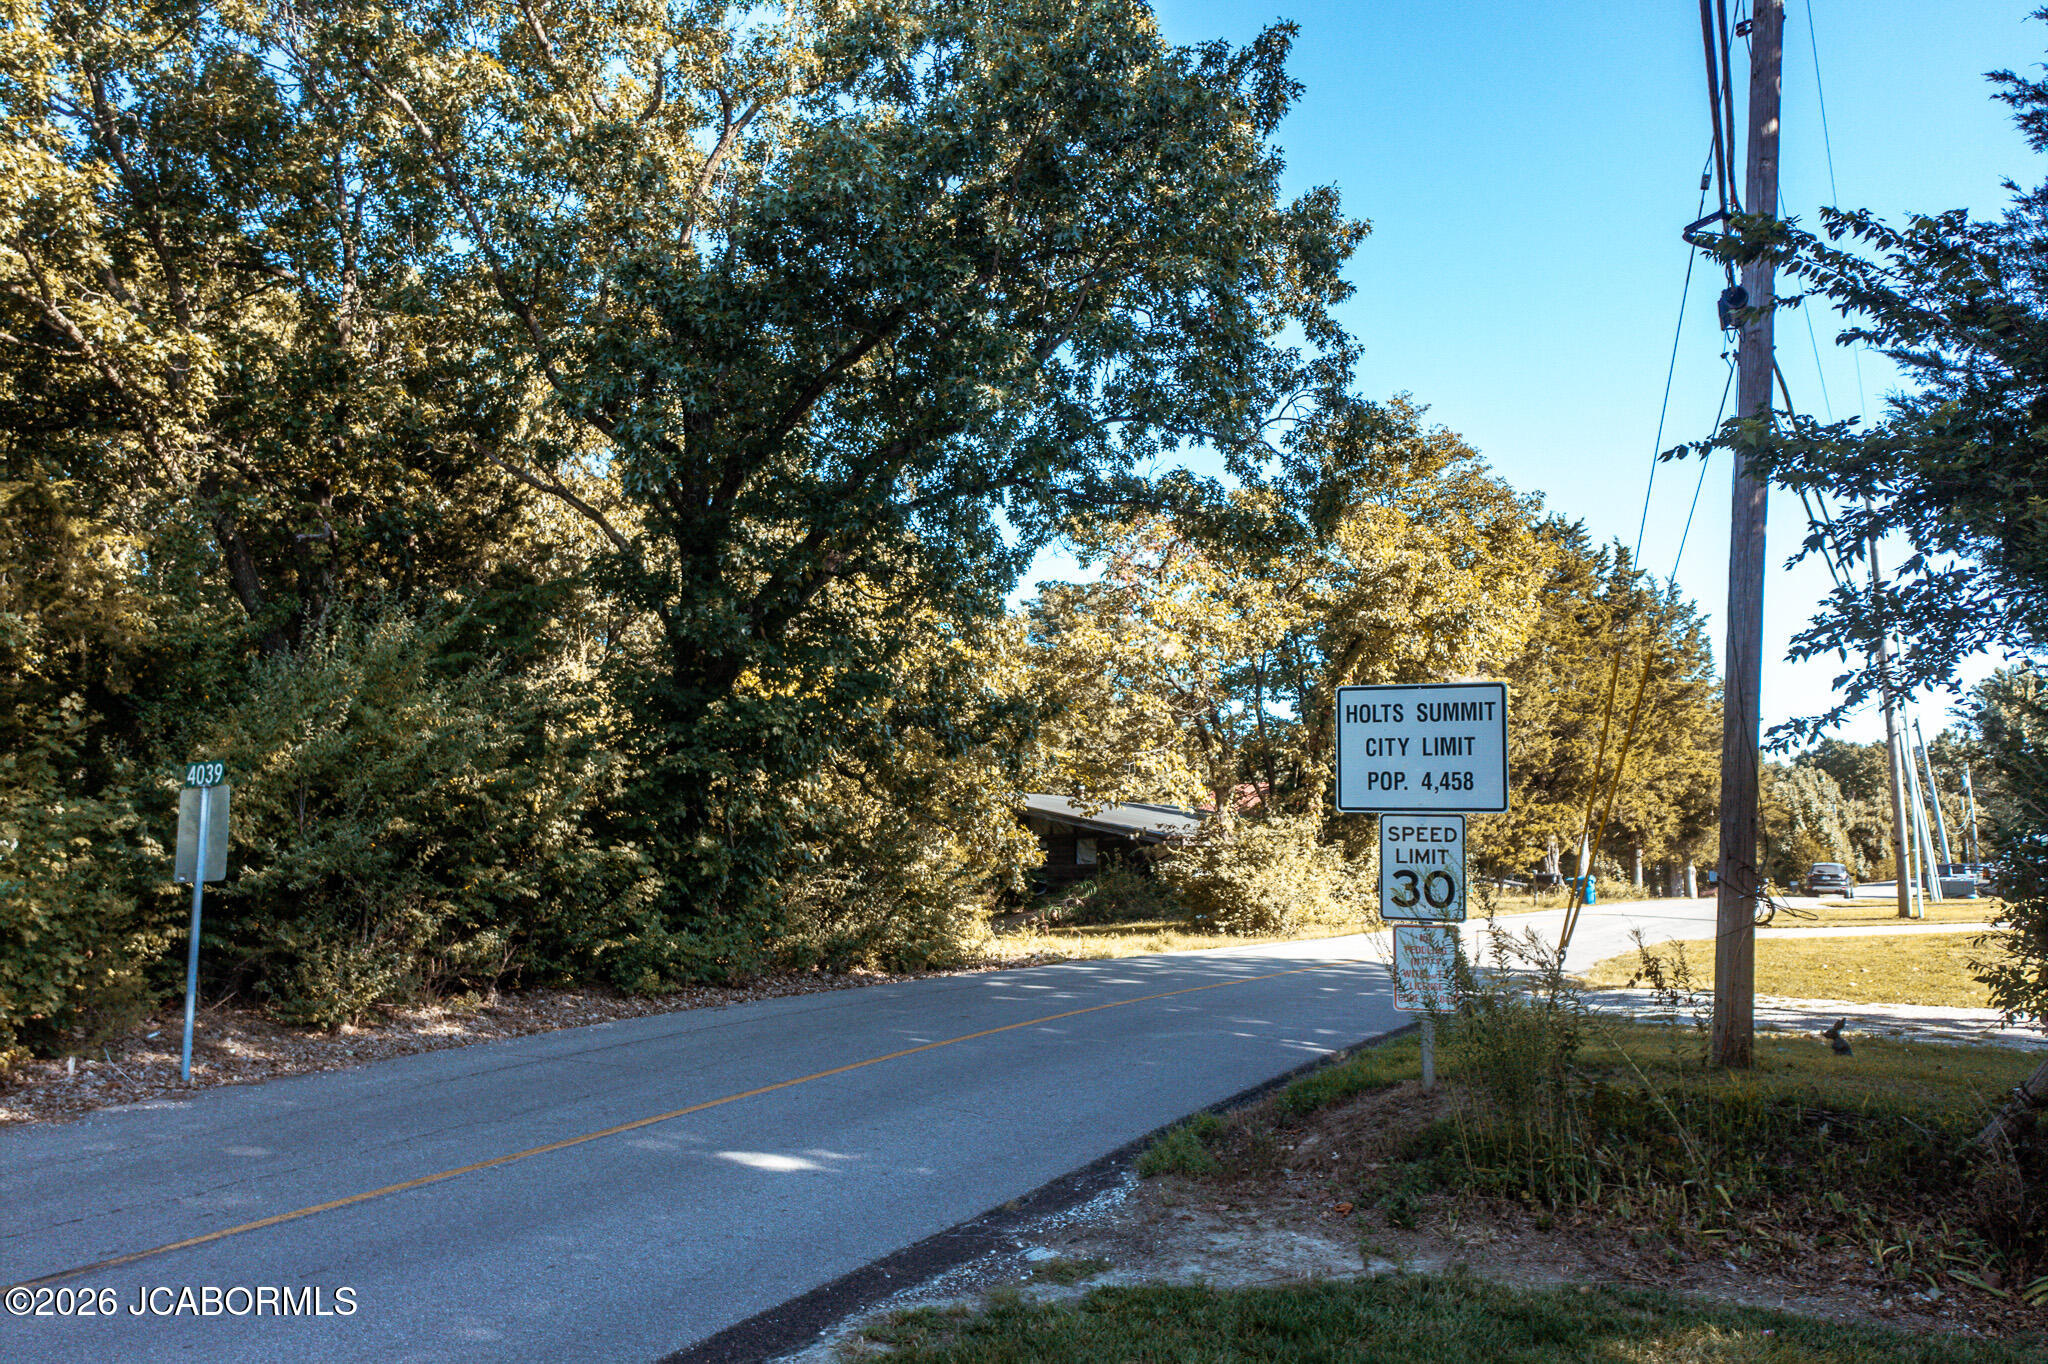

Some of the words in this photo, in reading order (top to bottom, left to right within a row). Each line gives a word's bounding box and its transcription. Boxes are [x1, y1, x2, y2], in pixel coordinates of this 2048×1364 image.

[1346, 703, 1404, 724] HOLTS
[1416, 701, 1496, 722] SUMMIT
[1365, 737, 1410, 757] CITY
[1422, 736, 1476, 757] LIMIT
[187, 763, 223, 786] 4039
[1367, 771, 1409, 791] POP.
[1421, 771, 1474, 794] 4,458
[1387, 826, 1457, 843] SPEED
[1395, 848, 1449, 865] LIMIT
[1391, 869, 1455, 909] 30
